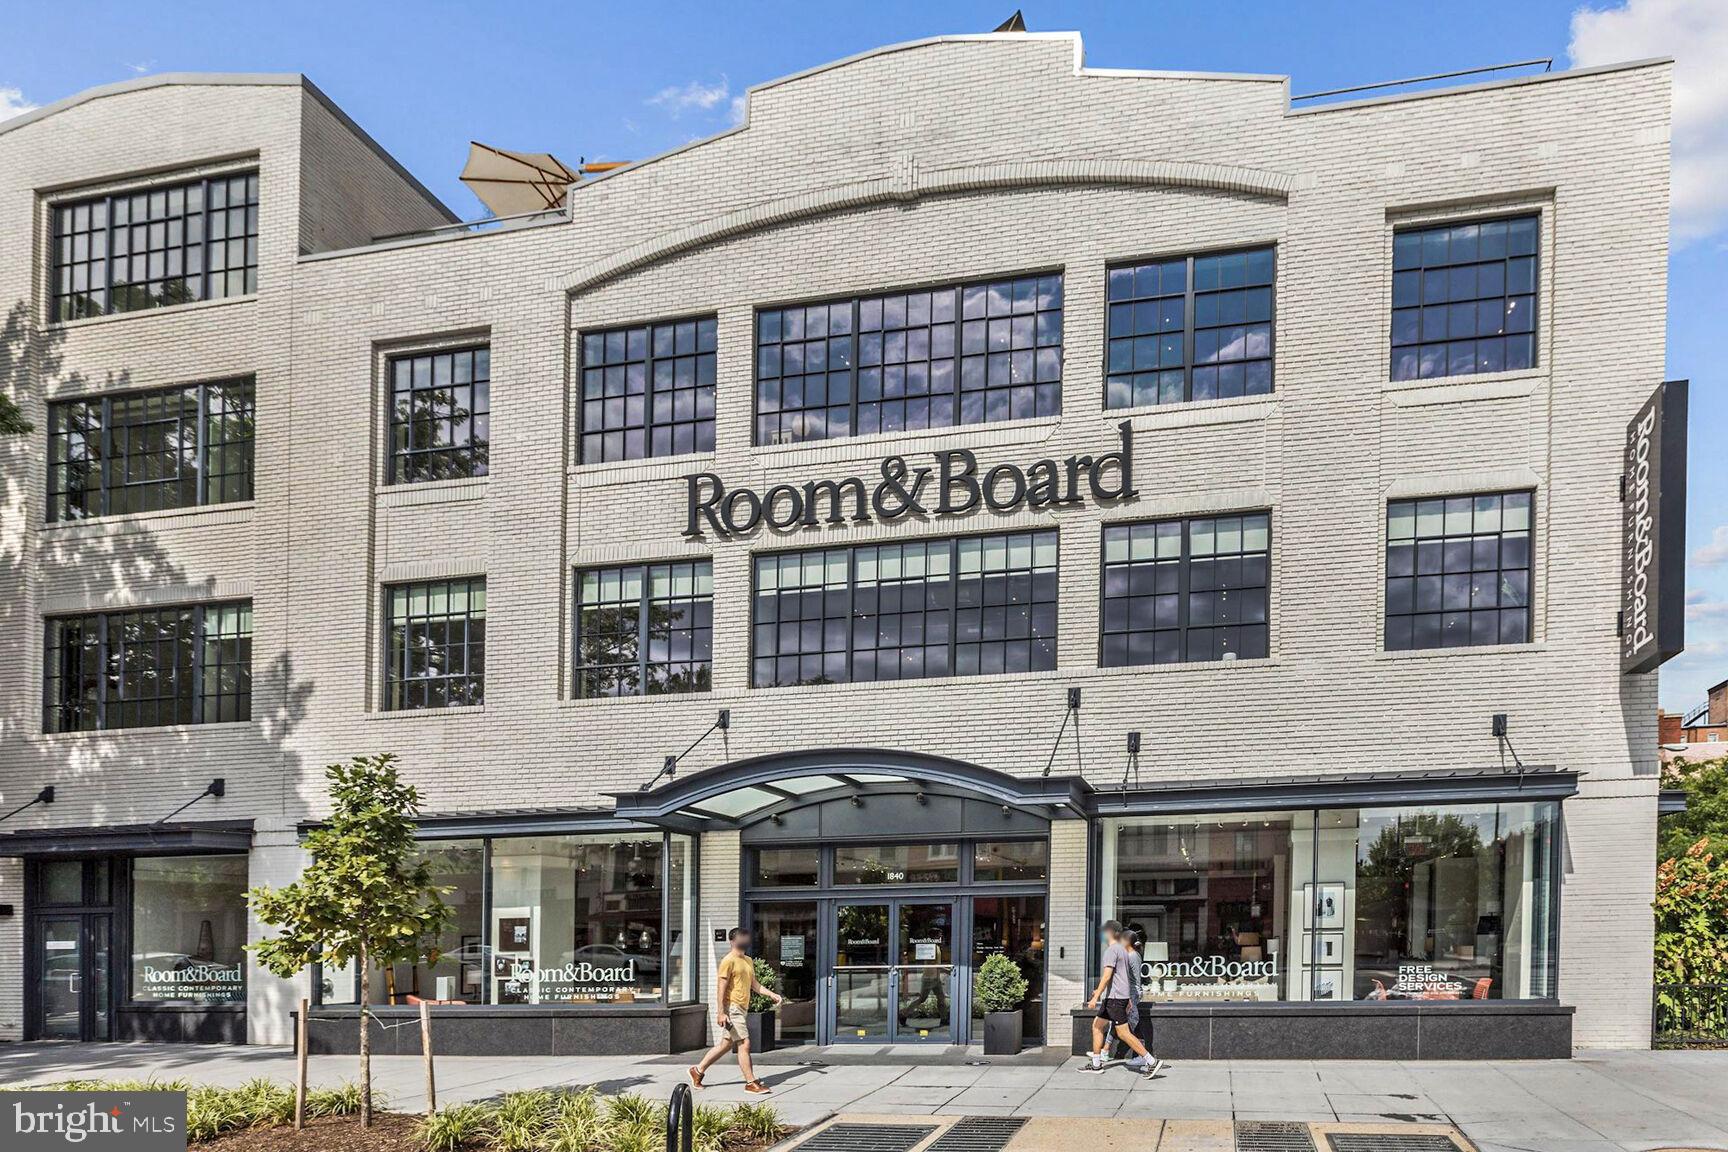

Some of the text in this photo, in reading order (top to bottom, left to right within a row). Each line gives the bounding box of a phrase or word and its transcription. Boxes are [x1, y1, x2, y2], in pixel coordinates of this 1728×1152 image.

[681, 420, 1139, 537] Room&Board
[1633, 405, 1656, 655] Room&Board
[1625, 431, 1637, 658] HOME FURNISHINGS
[887, 872, 904, 880] 1840
[144, 963, 242, 982] Room&Board
[1140, 951, 1279, 978] oom&Board
[1398, 965, 1432, 974] FREE
[1398, 974, 1448, 982] DESIGN
